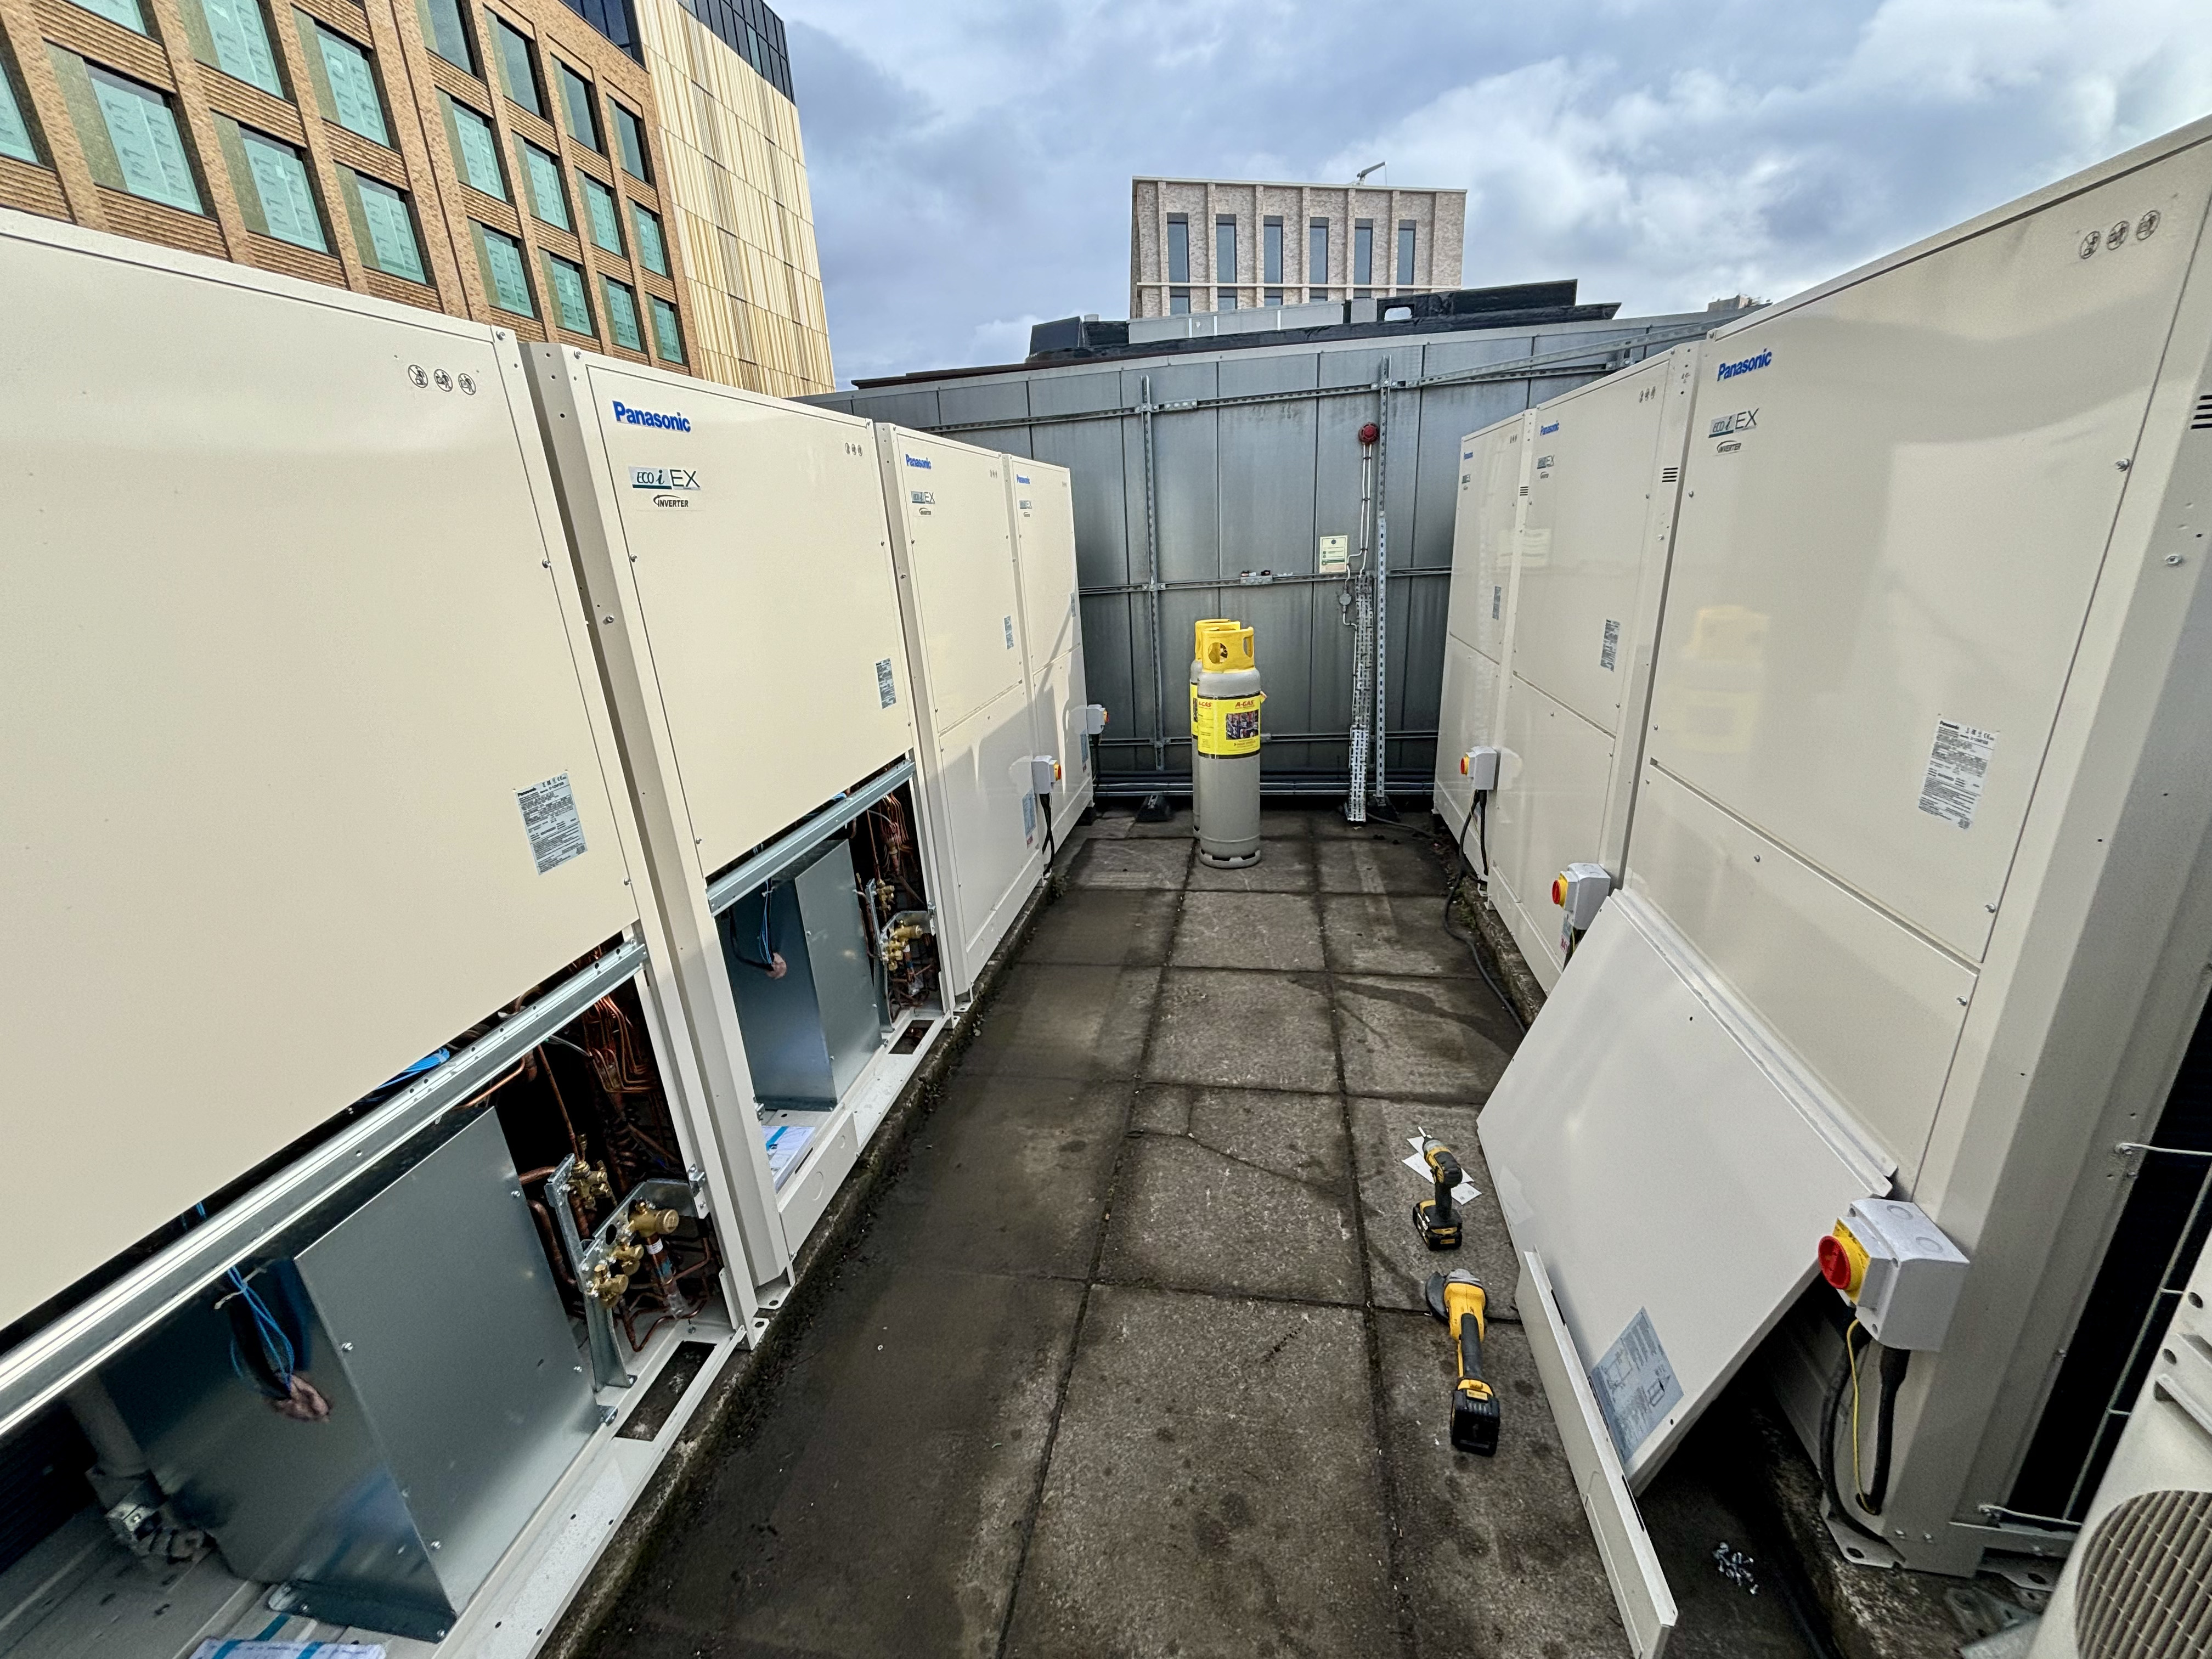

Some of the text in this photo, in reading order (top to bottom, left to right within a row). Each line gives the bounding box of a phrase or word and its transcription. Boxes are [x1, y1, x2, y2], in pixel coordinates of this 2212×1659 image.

[1717, 348, 1772, 381] Panasonic
[613, 400, 691, 432] Panasonic
[1735, 408, 1759, 429] EX
[906, 454, 932, 469] Panasonic
[670, 470, 700, 488] EX
[658, 499, 688, 507] INVERTER
